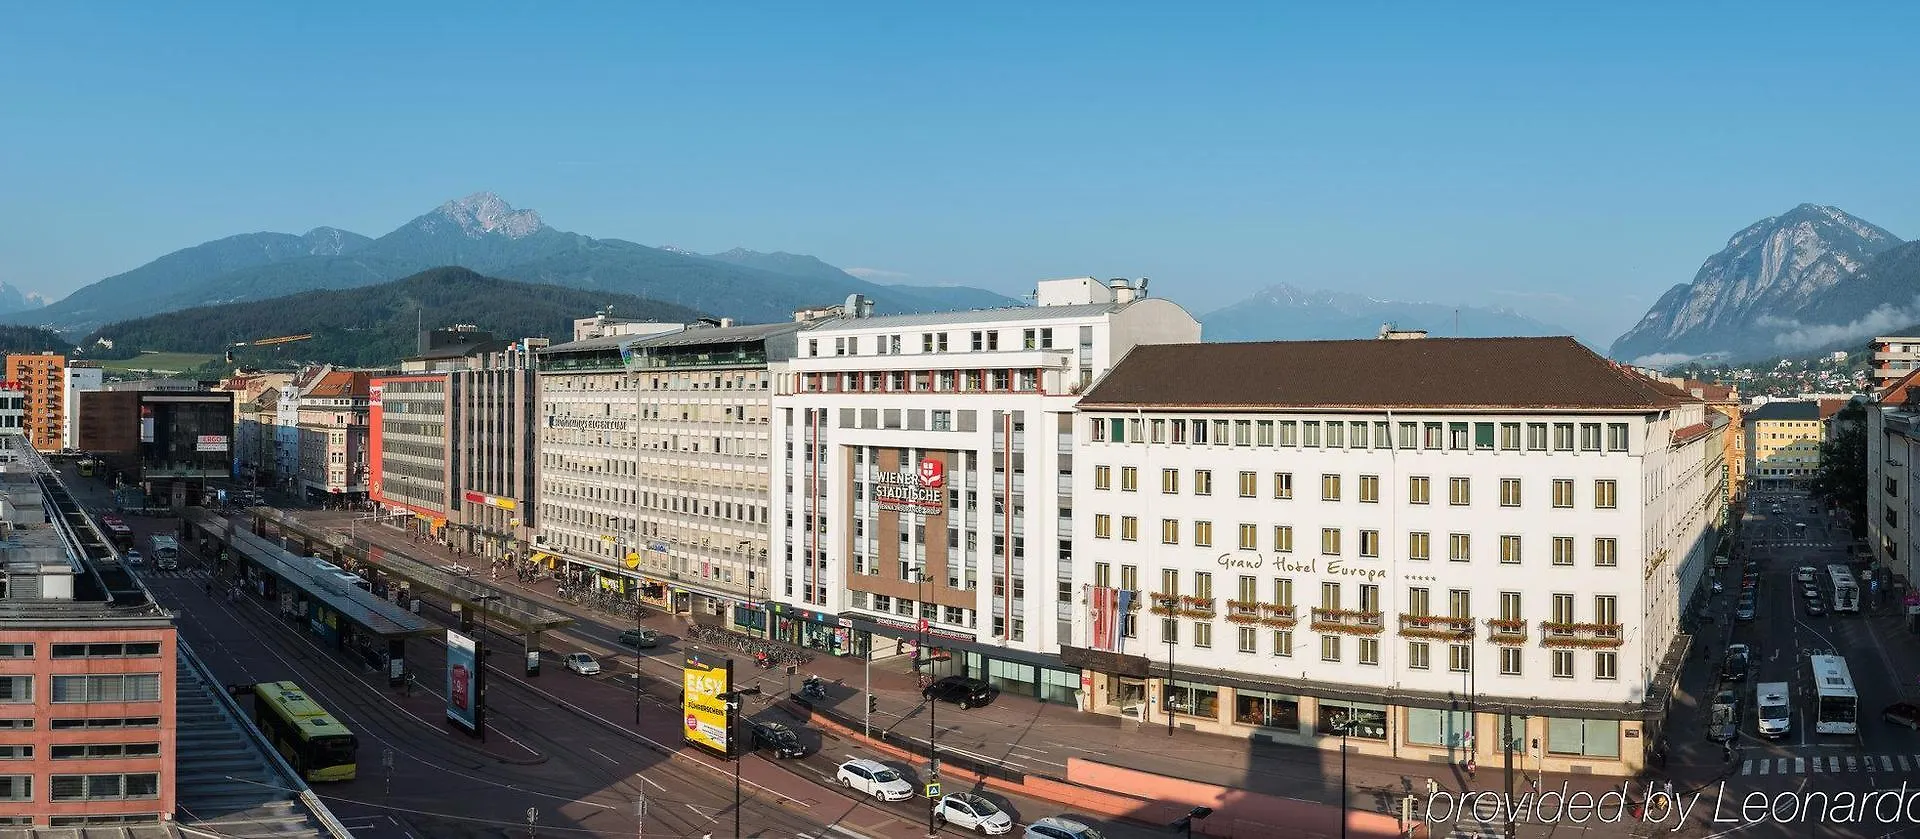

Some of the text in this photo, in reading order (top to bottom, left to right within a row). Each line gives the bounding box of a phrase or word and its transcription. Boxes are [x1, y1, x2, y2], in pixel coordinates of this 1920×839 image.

[876, 471, 919, 486] WIENER
[876, 485, 940, 502] STÄDTISCHE
[1217, 553, 1386, 581] Grand Hotel Europa
[686, 671, 724, 695] EASY
